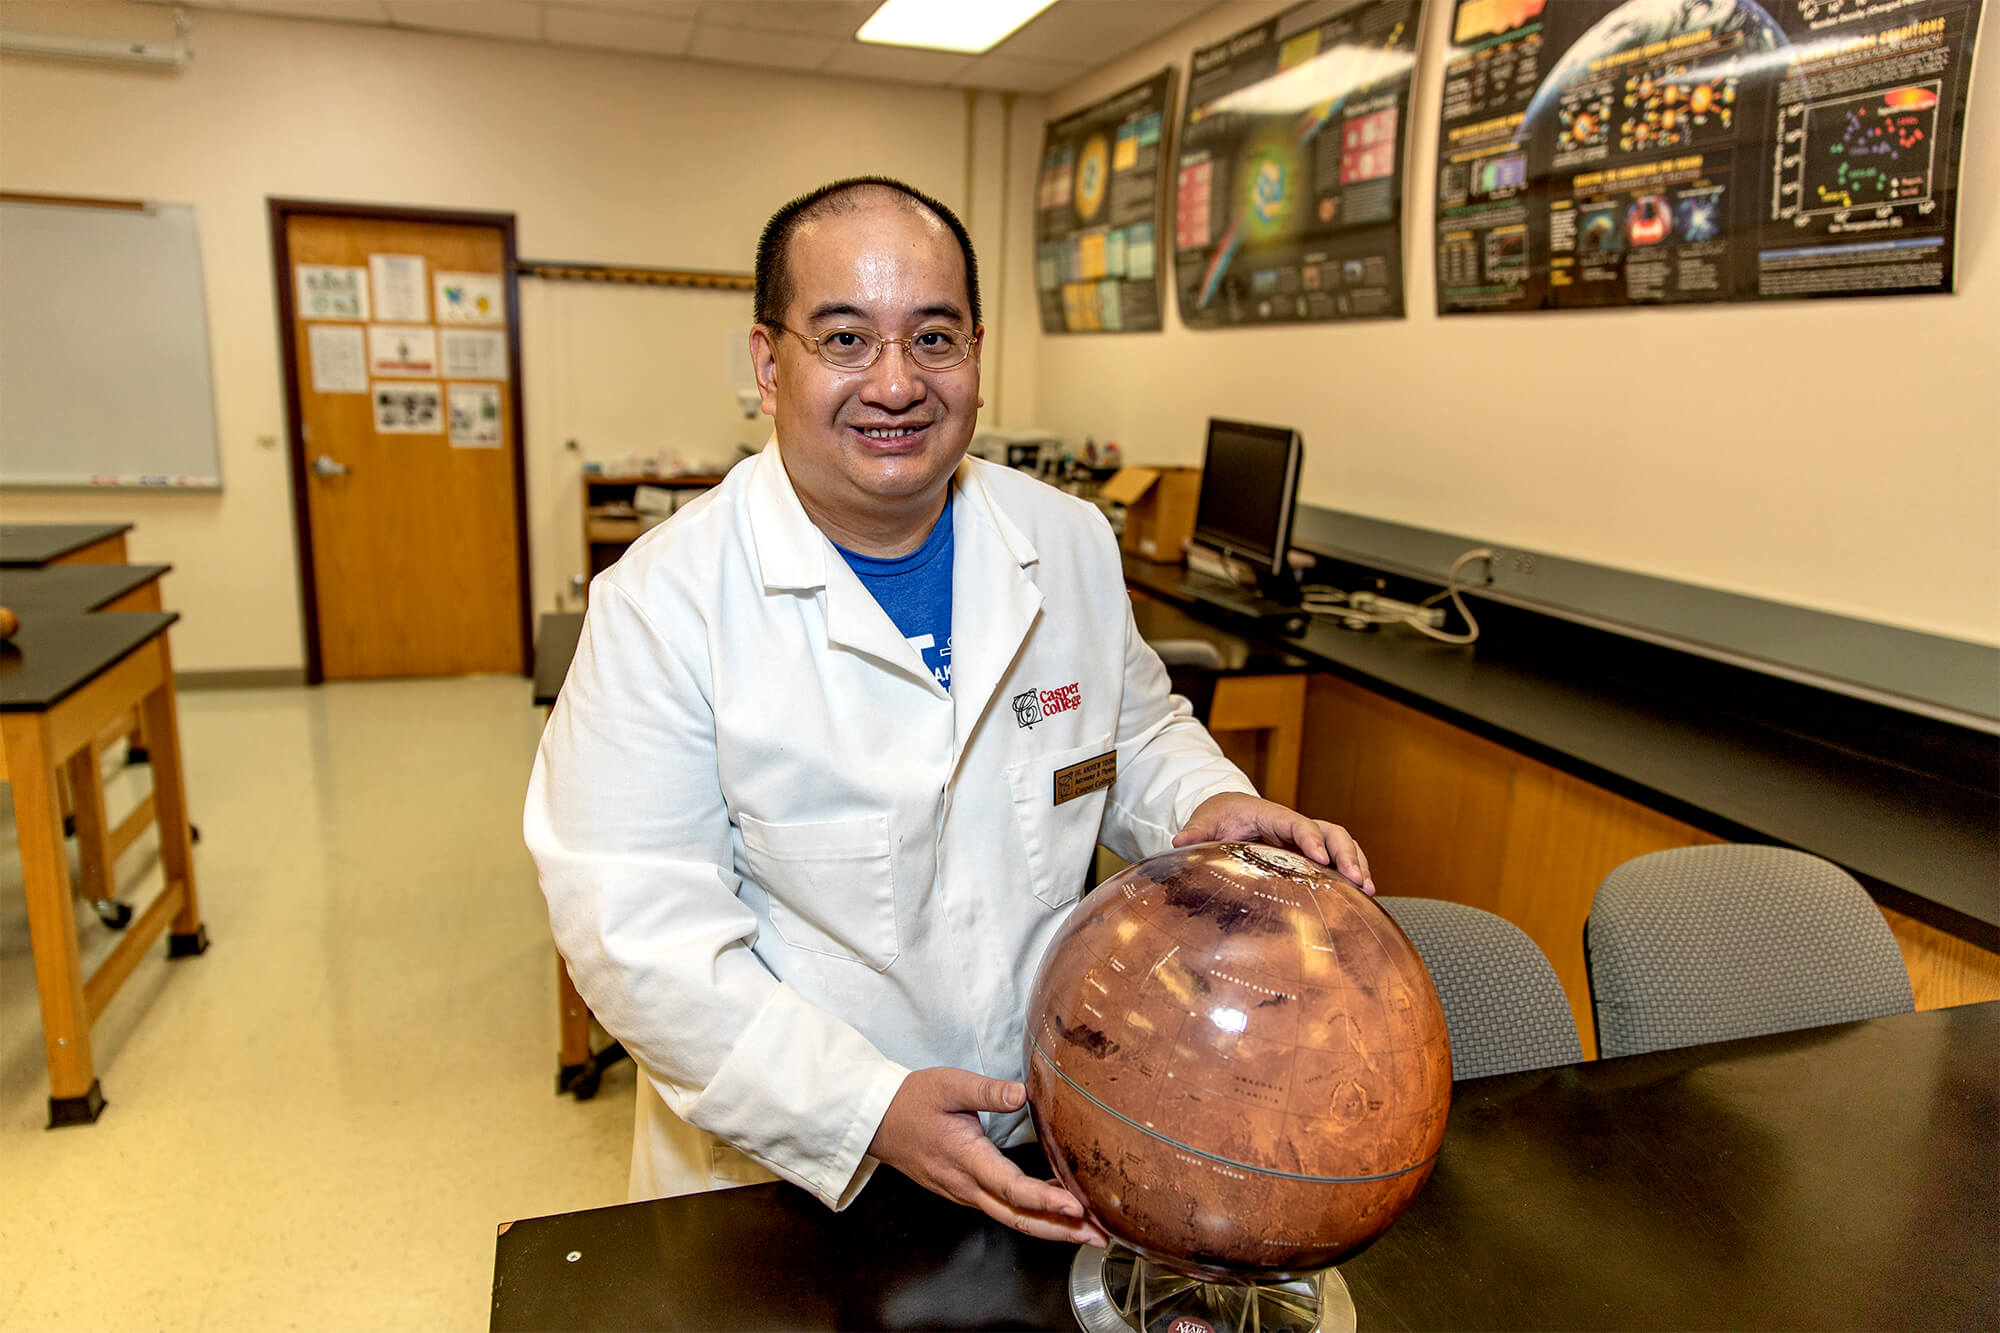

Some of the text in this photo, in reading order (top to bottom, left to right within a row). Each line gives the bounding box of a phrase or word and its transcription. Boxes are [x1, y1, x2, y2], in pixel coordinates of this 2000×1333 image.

[1040, 682, 1079, 703] Casper
[1043, 694, 1081, 717] College
[1075, 783, 1094, 795] Casper
[1209, 969, 1297, 1001] ARCADIA PLANITIA
